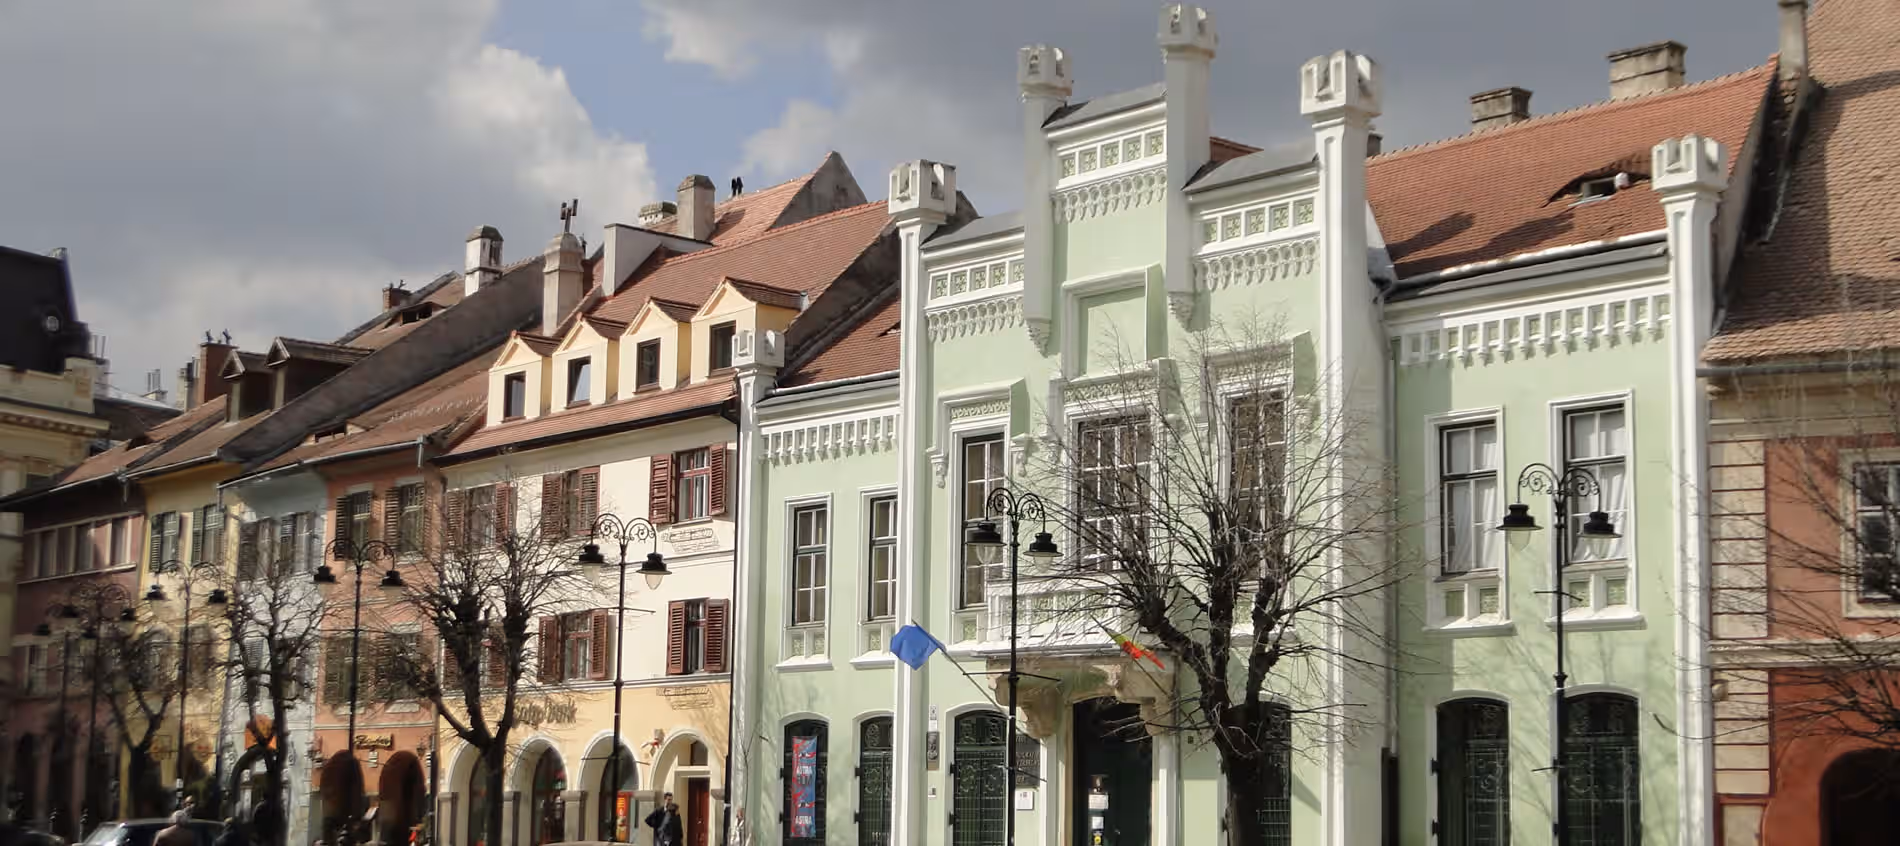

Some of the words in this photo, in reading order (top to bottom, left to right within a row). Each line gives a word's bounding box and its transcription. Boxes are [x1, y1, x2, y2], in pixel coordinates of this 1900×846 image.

[545, 696, 577, 723] bank
[796, 765, 813, 775] ASTRA
[795, 815, 813, 825] ASTRA
